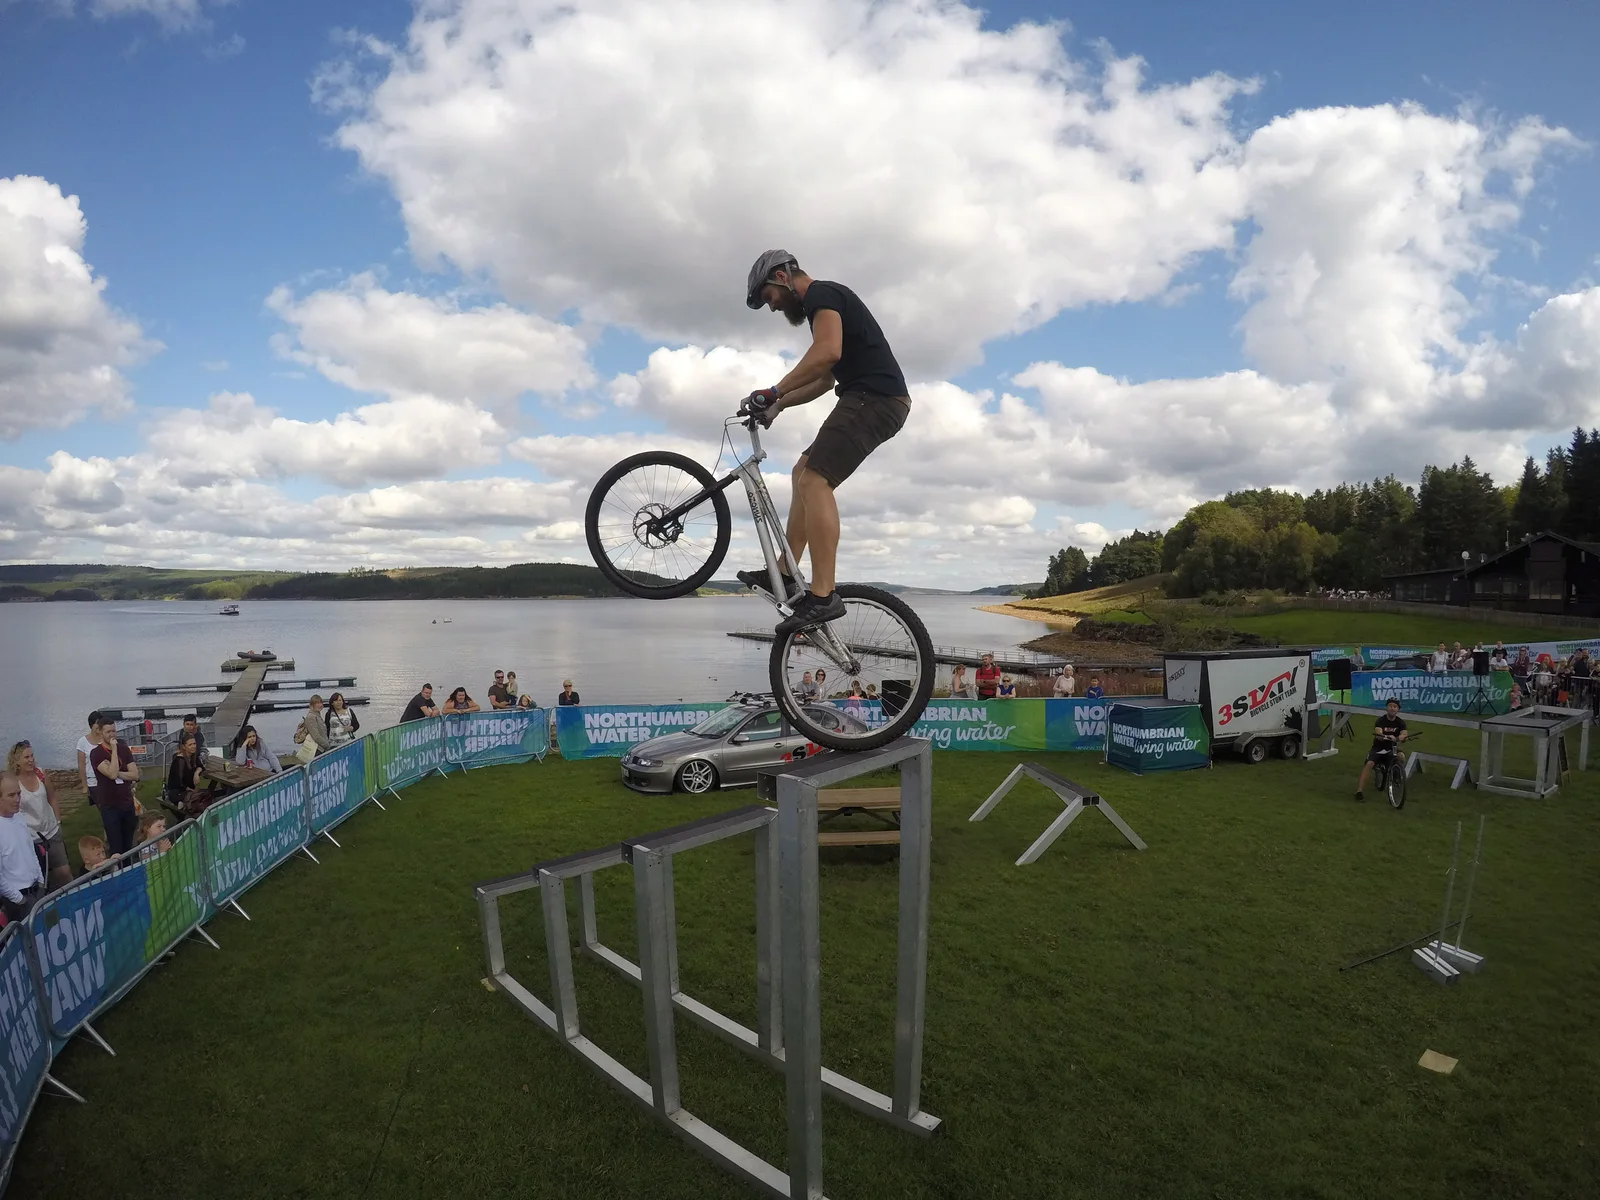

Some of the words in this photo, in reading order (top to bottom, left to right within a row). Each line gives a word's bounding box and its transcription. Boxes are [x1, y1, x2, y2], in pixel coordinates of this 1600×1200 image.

[1371, 675, 1491, 689] NORTHUMBRIAN
[1218, 665, 1299, 726] 3SIXTY
[1249, 701, 1271, 718] BICYCLE
[1270, 695, 1285, 708] STUNT
[1284, 686, 1297, 700] TEAM
[1372, 689, 1419, 701] WATER
[1419, 687, 1464, 711] living
[586, 727, 651, 743] WATER
[956, 721, 1016, 741] water
[1112, 722, 1185, 739] NORTHUMBRIAN
[1113, 732, 1135, 748] WATER
[1134, 740, 1165, 759] living
[1166, 736, 1201, 753] water
